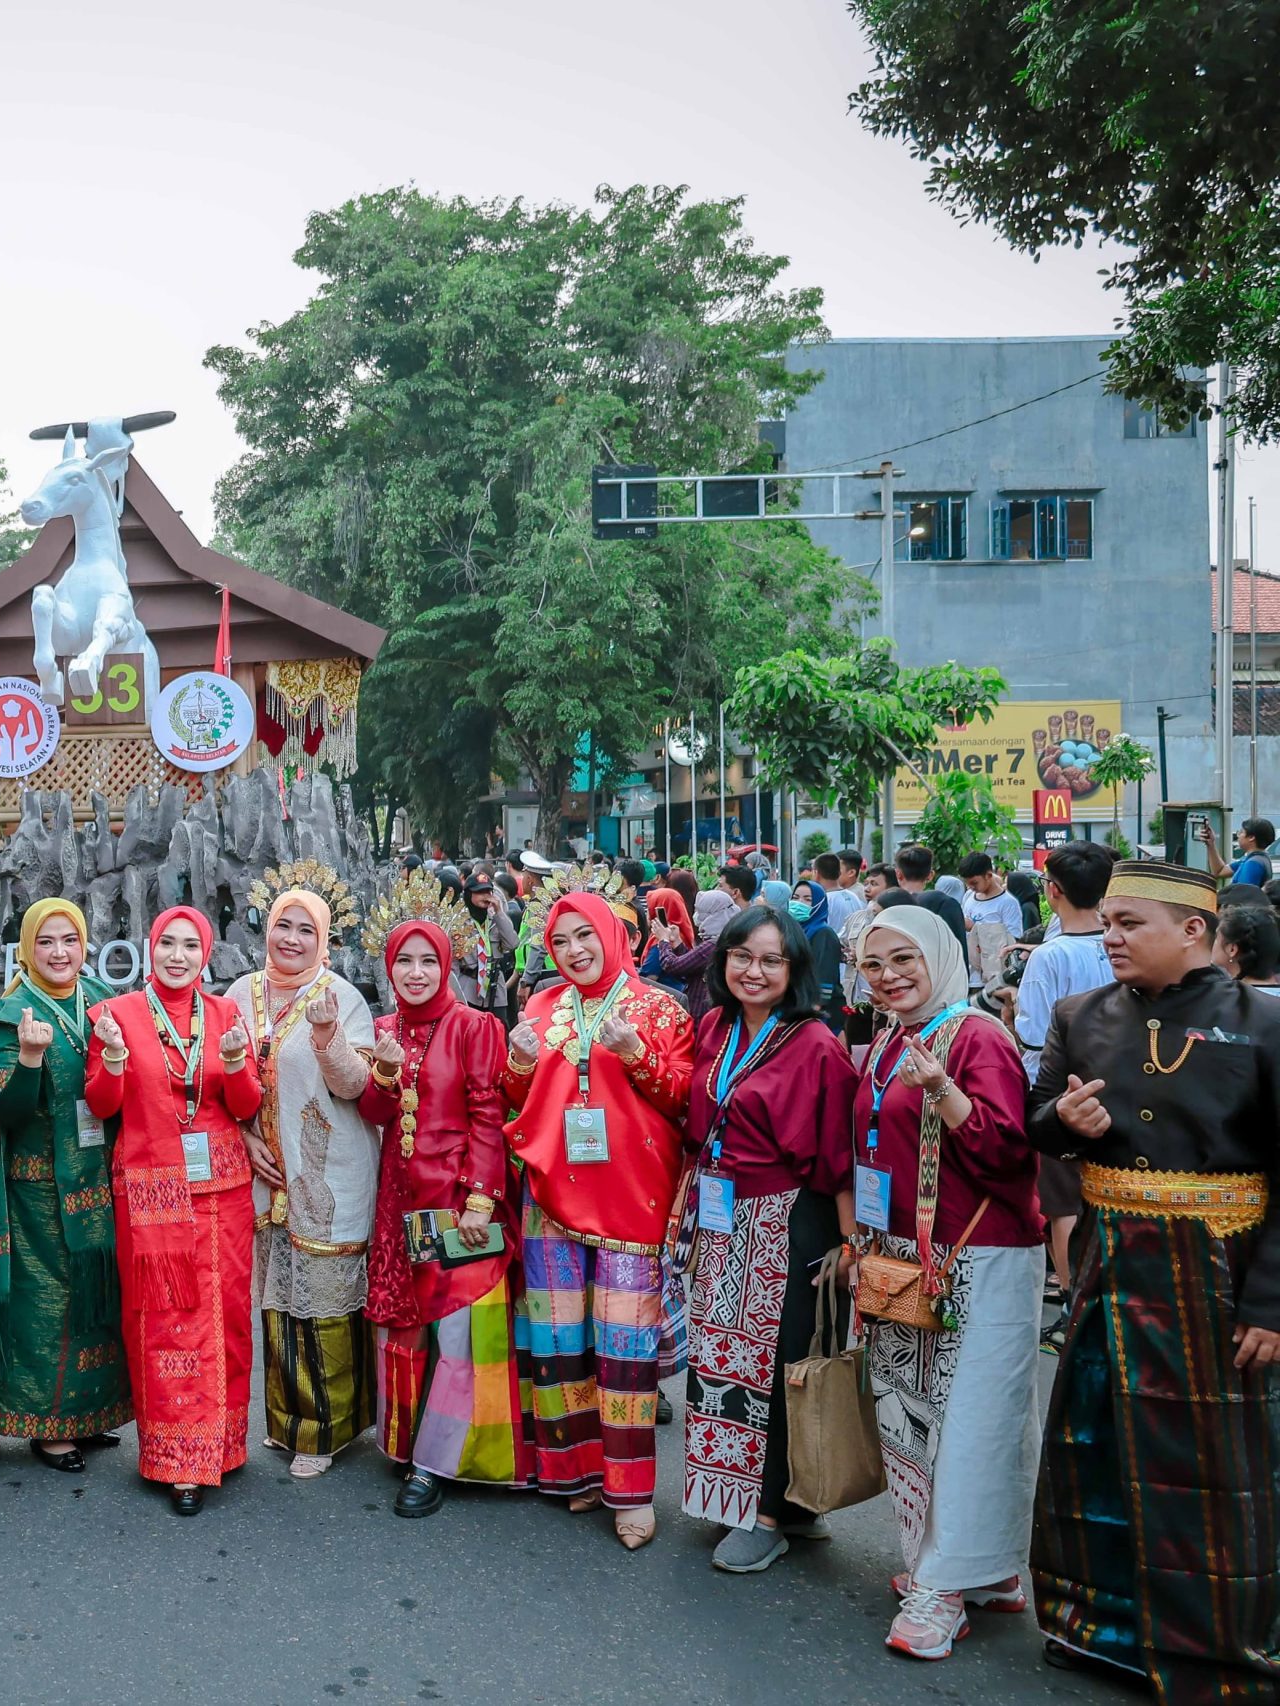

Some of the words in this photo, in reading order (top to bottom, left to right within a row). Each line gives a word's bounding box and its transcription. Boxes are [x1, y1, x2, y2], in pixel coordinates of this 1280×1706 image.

[10, 682, 45, 707] NASION
[45, 707, 55, 742] DAERAH
[989, 737, 1026, 748] dengan
[15, 748, 48, 773] SELATAN
[910, 748, 999, 775] aMer
[1005, 748, 1025, 774] 7
[896, 779, 917, 789] Aya
[992, 778, 1004, 786] uit
[1007, 777, 1026, 786] Tea
[1045, 830, 1067, 839] DRIVE
